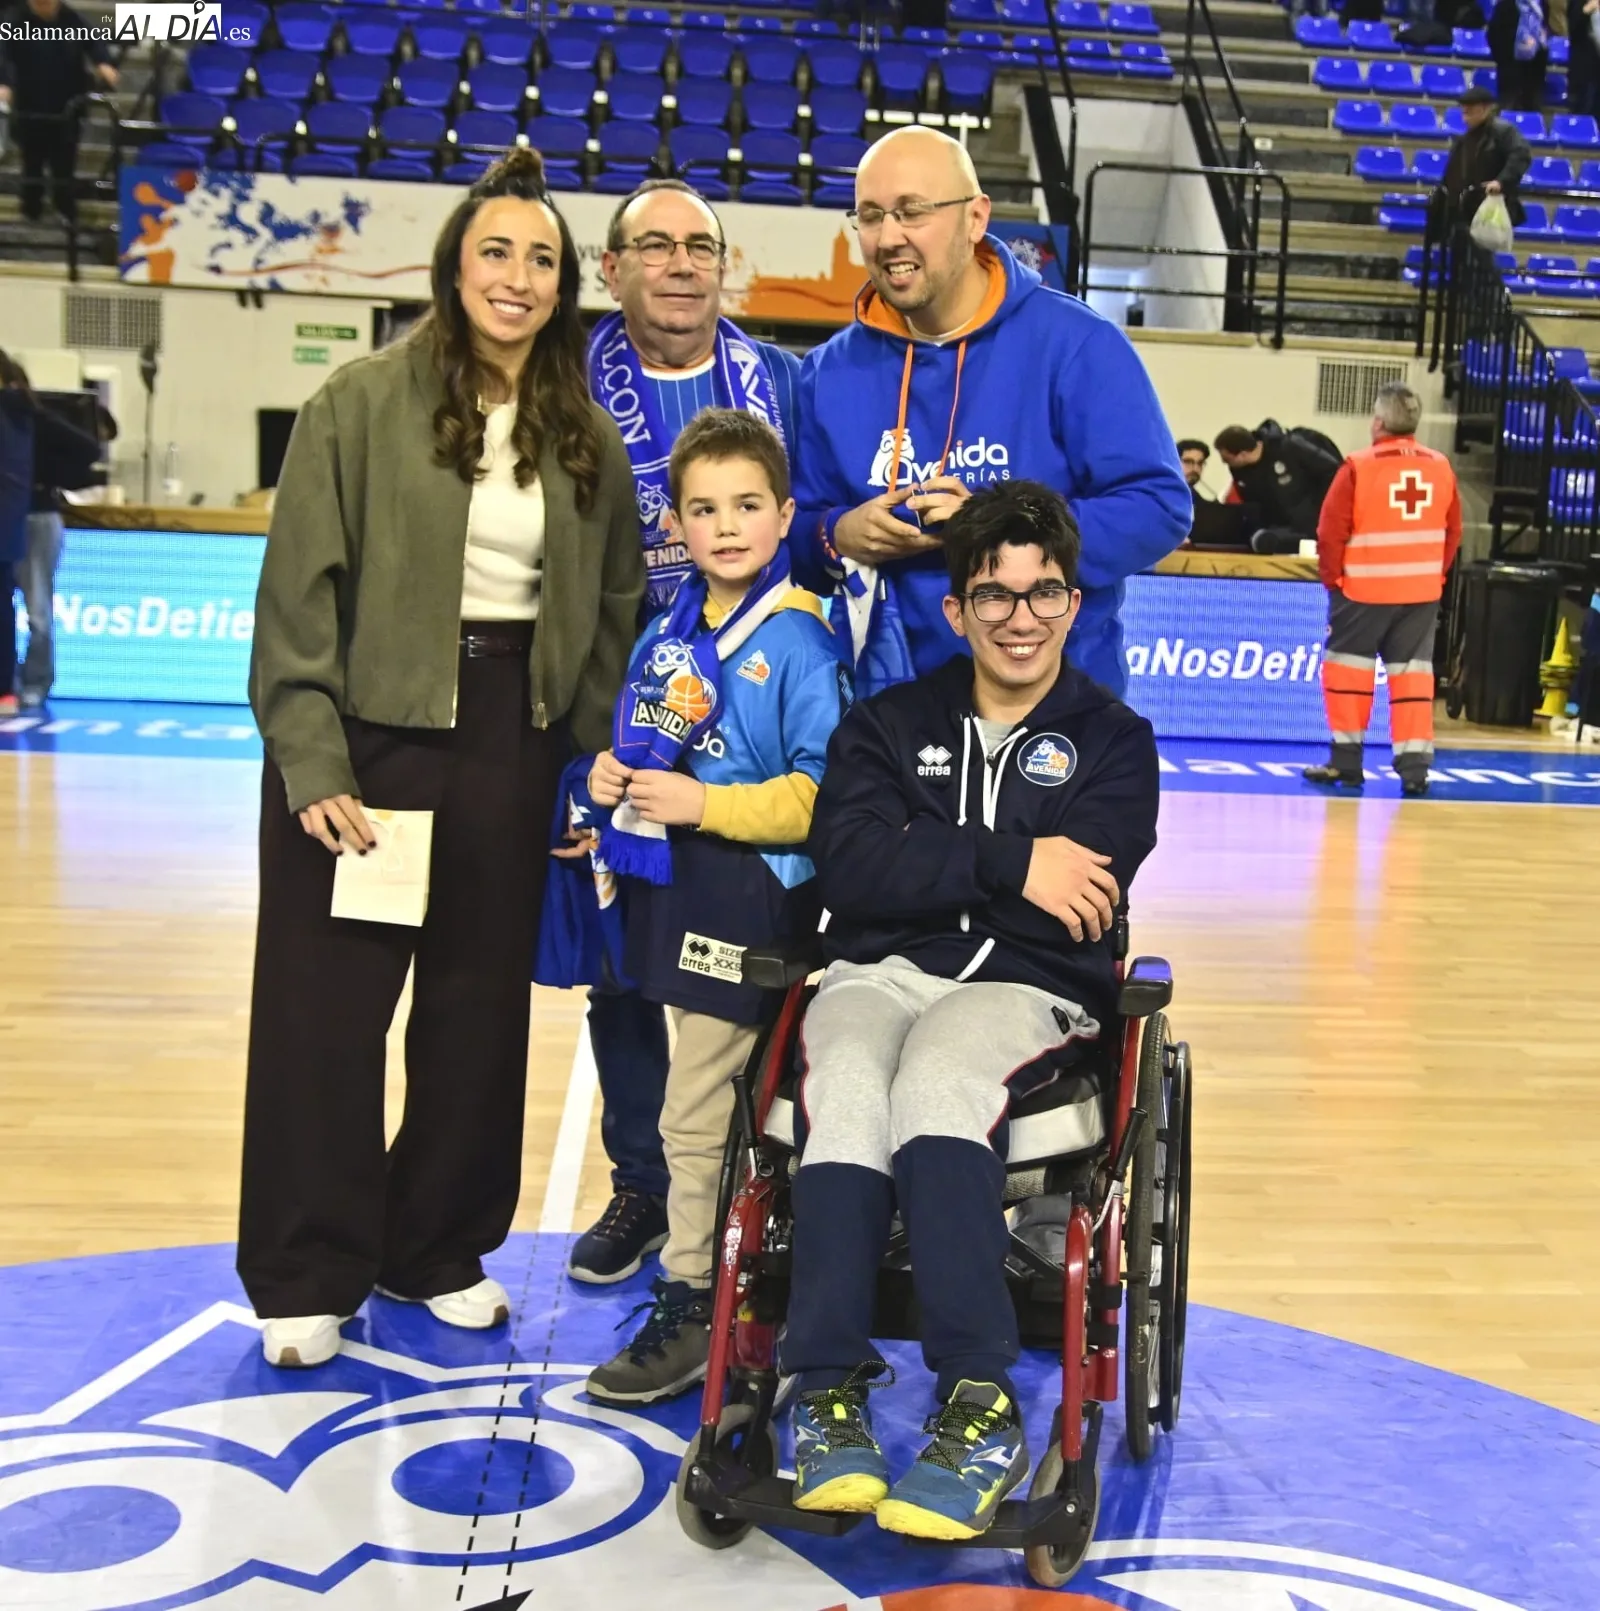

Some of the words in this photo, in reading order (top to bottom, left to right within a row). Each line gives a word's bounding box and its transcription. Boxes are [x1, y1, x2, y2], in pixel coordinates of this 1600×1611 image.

[917, 765, 951, 777] errea
[681, 956, 712, 974] errea
[713, 957, 742, 972] XXS
